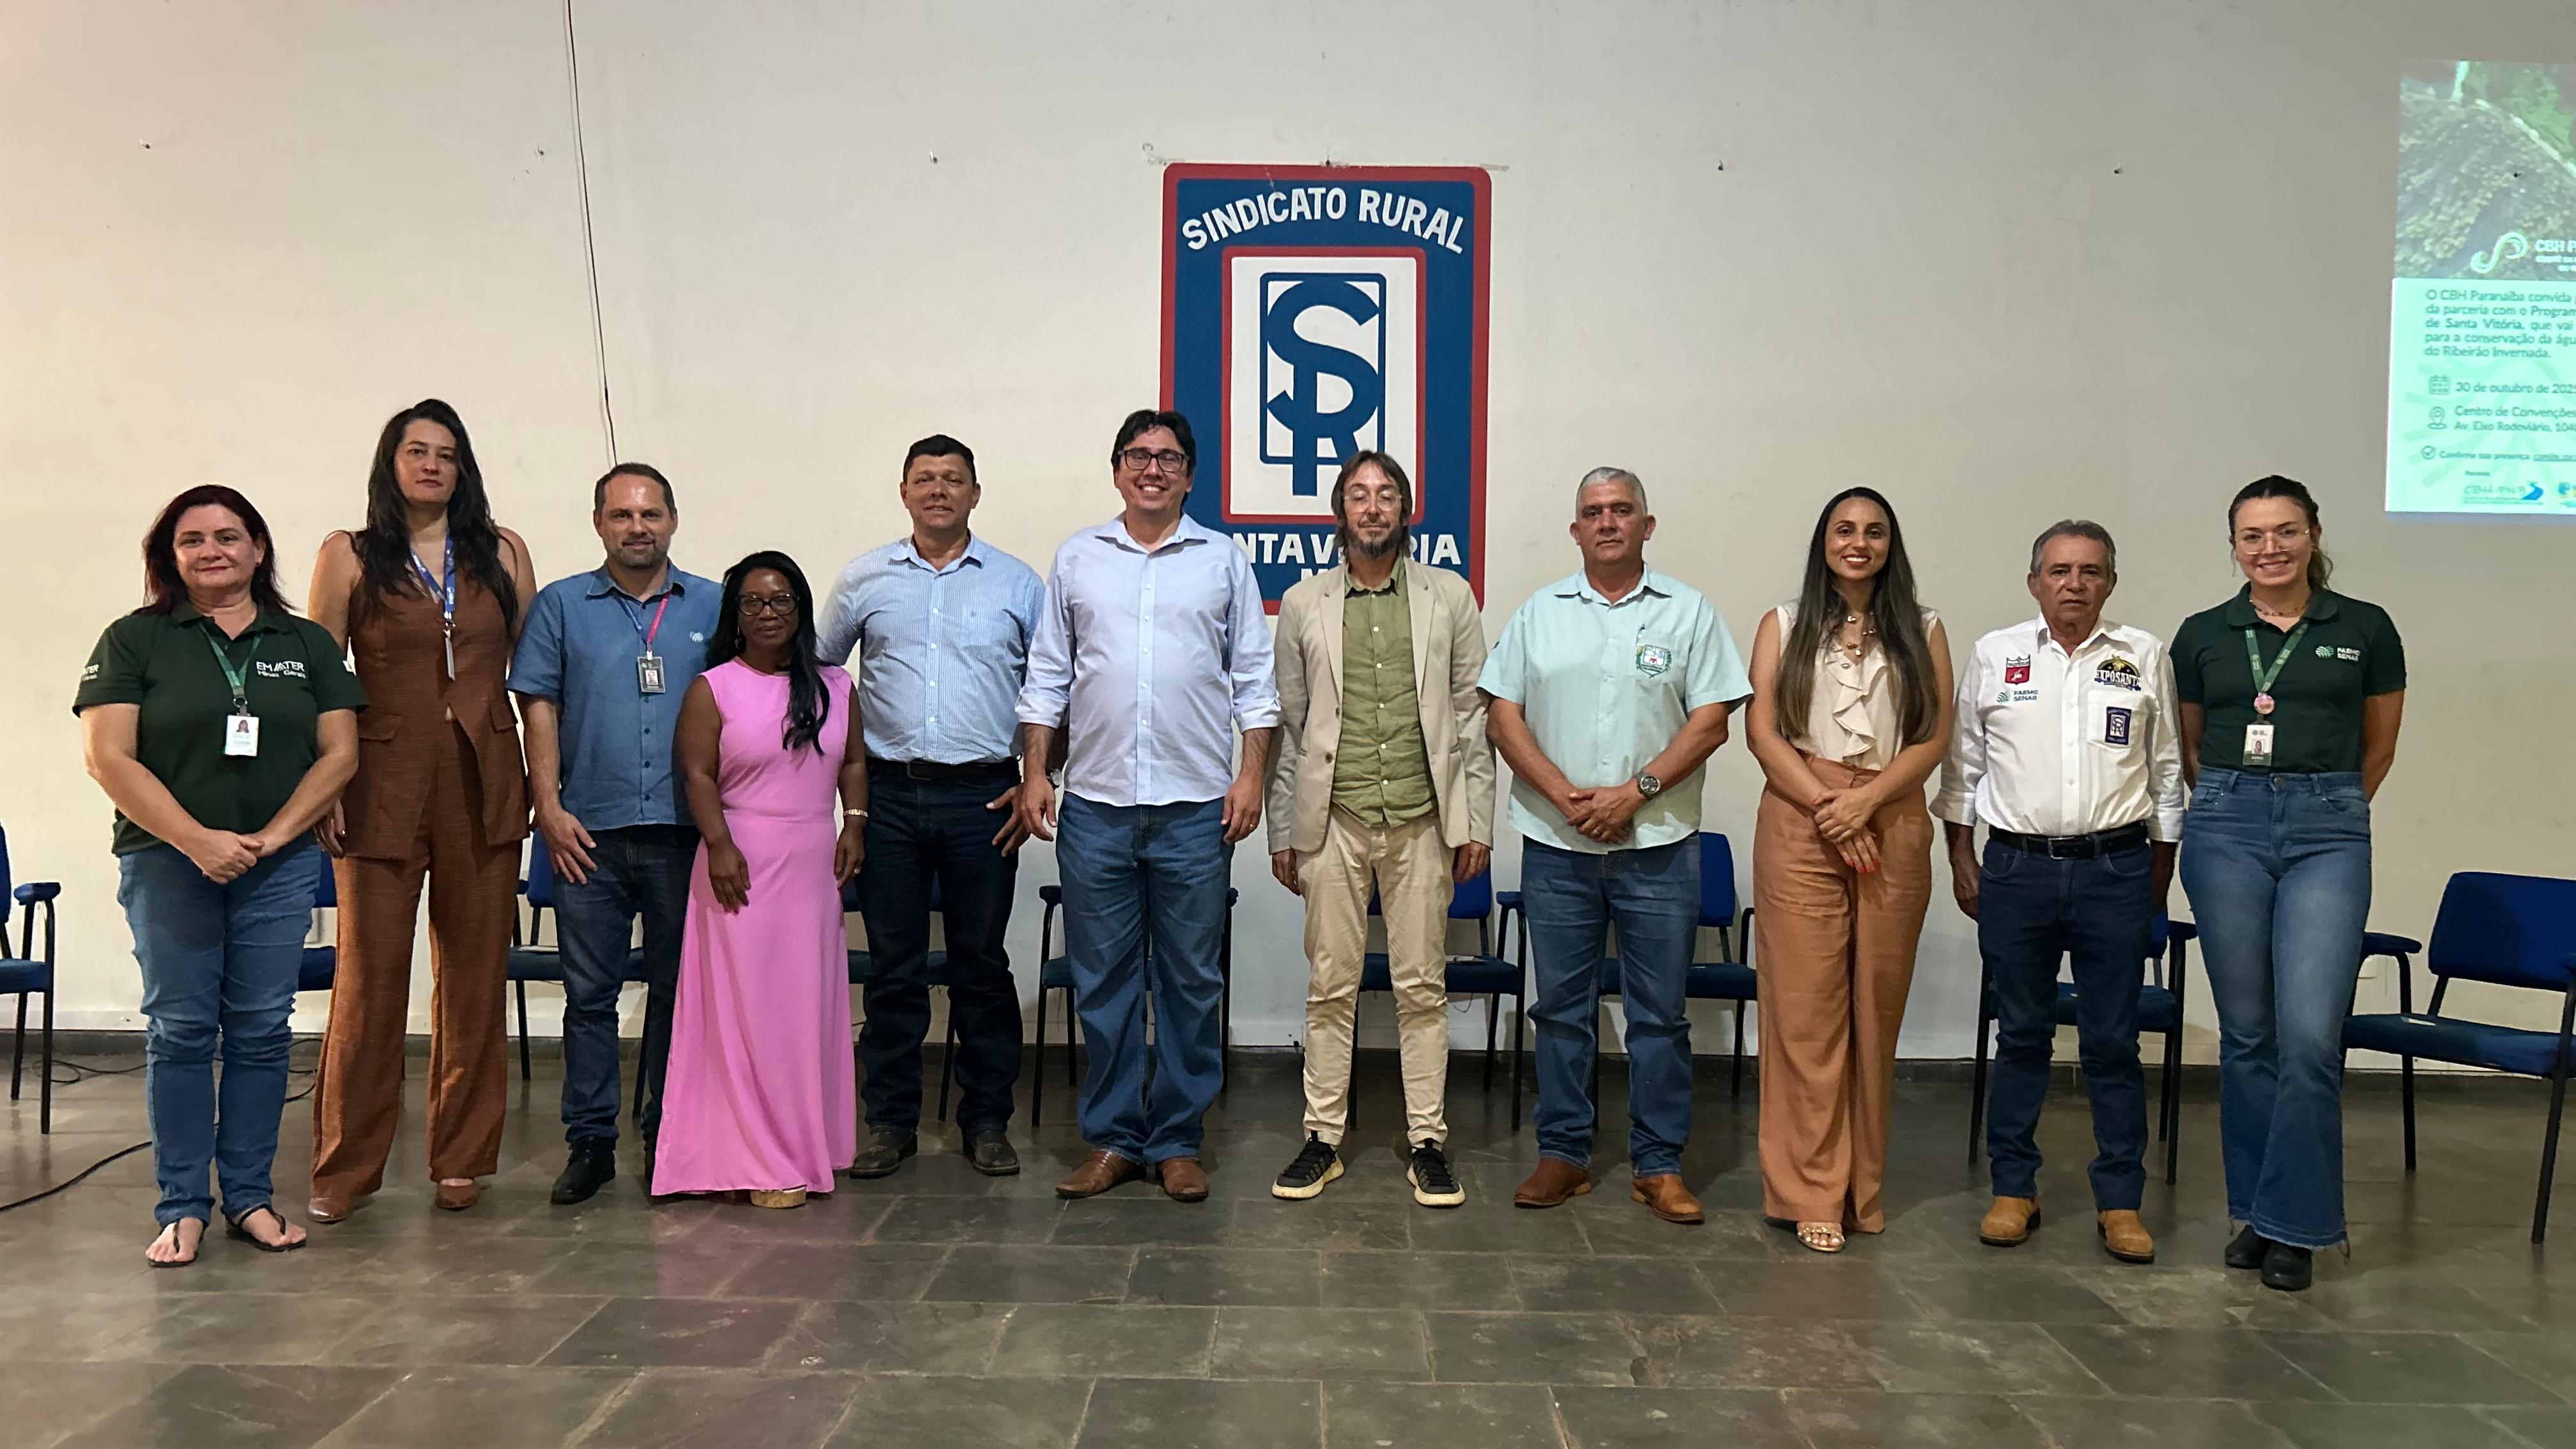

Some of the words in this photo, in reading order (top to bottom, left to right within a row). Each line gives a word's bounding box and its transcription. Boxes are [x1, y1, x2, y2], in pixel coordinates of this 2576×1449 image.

[1182, 187, 1346, 250] SINDICATO
[1358, 189, 1464, 254] RURAL
[2426, 289, 2437, 300] O
[2441, 289, 2467, 300] CBH
[2470, 290, 2524, 301] Paranaíba
[2529, 291, 2572, 302] convida
[2426, 303, 2440, 314] da
[2443, 305, 2488, 315] parceria
[2492, 307, 2516, 315] com
[2425, 318, 2440, 328] de
[2446, 318, 2477, 328] Santa
[2530, 321, 2552, 332] que
[2556, 321, 2573, 330] vai
[2425, 334, 2450, 343] para
[2464, 334, 2535, 345] conservação
[2538, 334, 2552, 344] da
[2425, 346, 2439, 356] do
[2442, 346, 2490, 356] Ribeirão
[2455, 381, 2471, 392] 30
[2473, 382, 2487, 392] de
[2490, 383, 2533, 393] outubro
[2536, 384, 2549, 393] de
[2454, 406, 2492, 416] Centro
[2495, 407, 2508, 417] de
[1232, 533, 1305, 564] NTA
